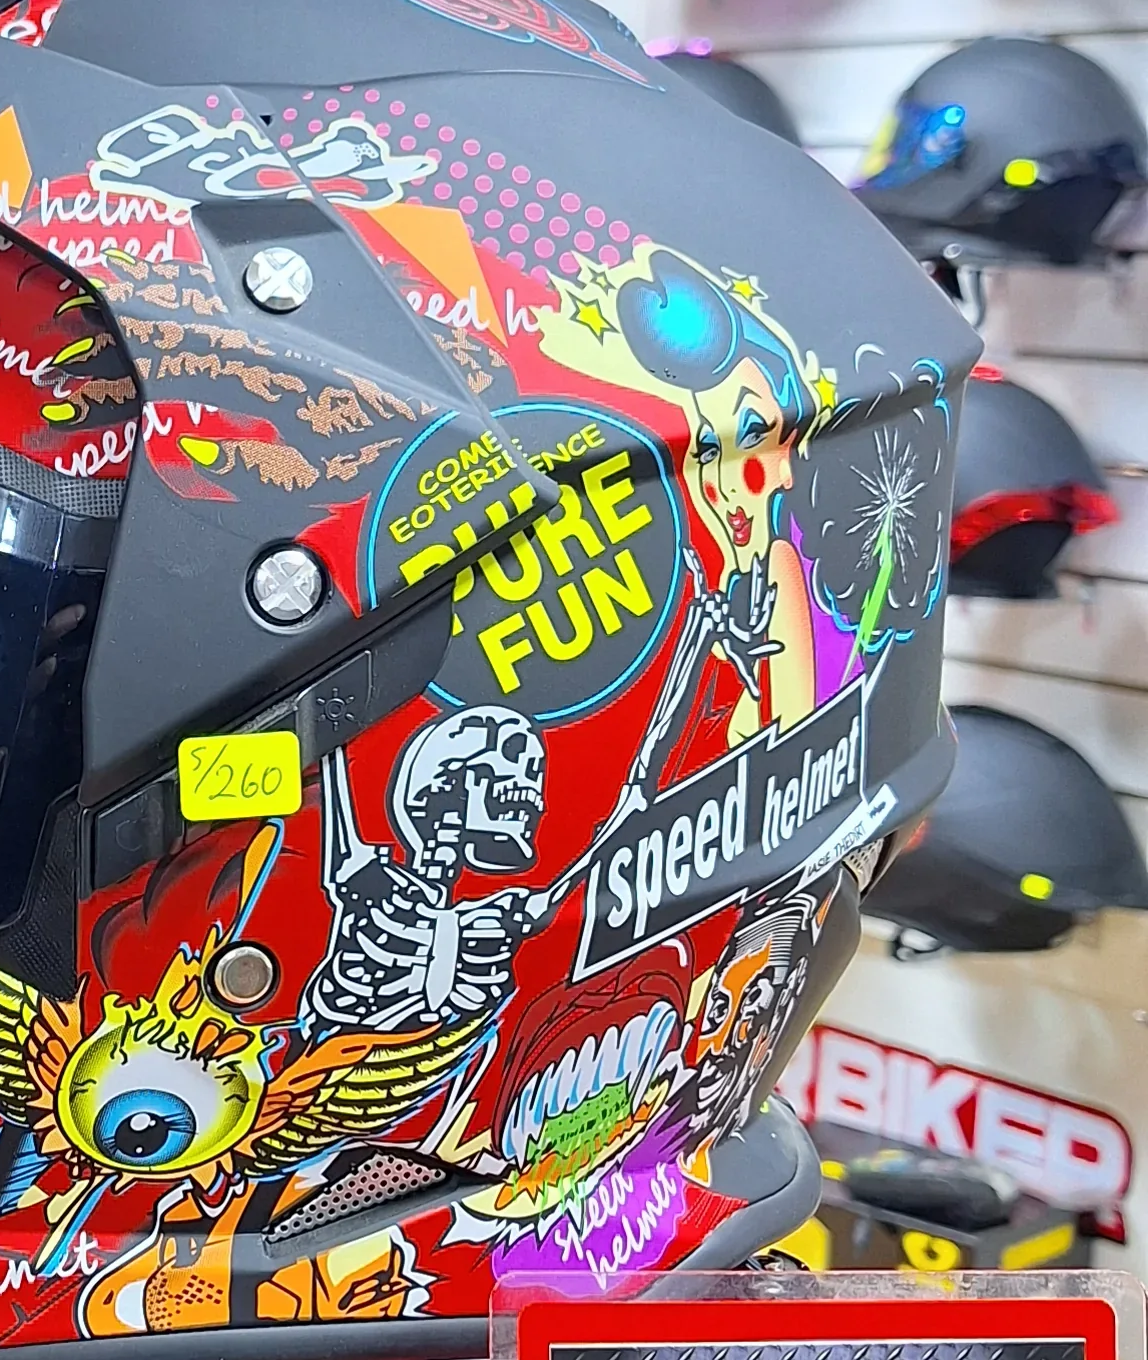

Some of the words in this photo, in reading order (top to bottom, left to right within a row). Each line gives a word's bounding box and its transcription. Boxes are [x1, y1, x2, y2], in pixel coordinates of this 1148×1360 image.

[418, 429, 504, 497] COME
[478, 549, 655, 694] FUN
[607, 752, 748, 940] speed
[761, 715, 861, 856] helmet
[554, 1167, 635, 1262] speed
[585, 1161, 678, 1290] helmet
